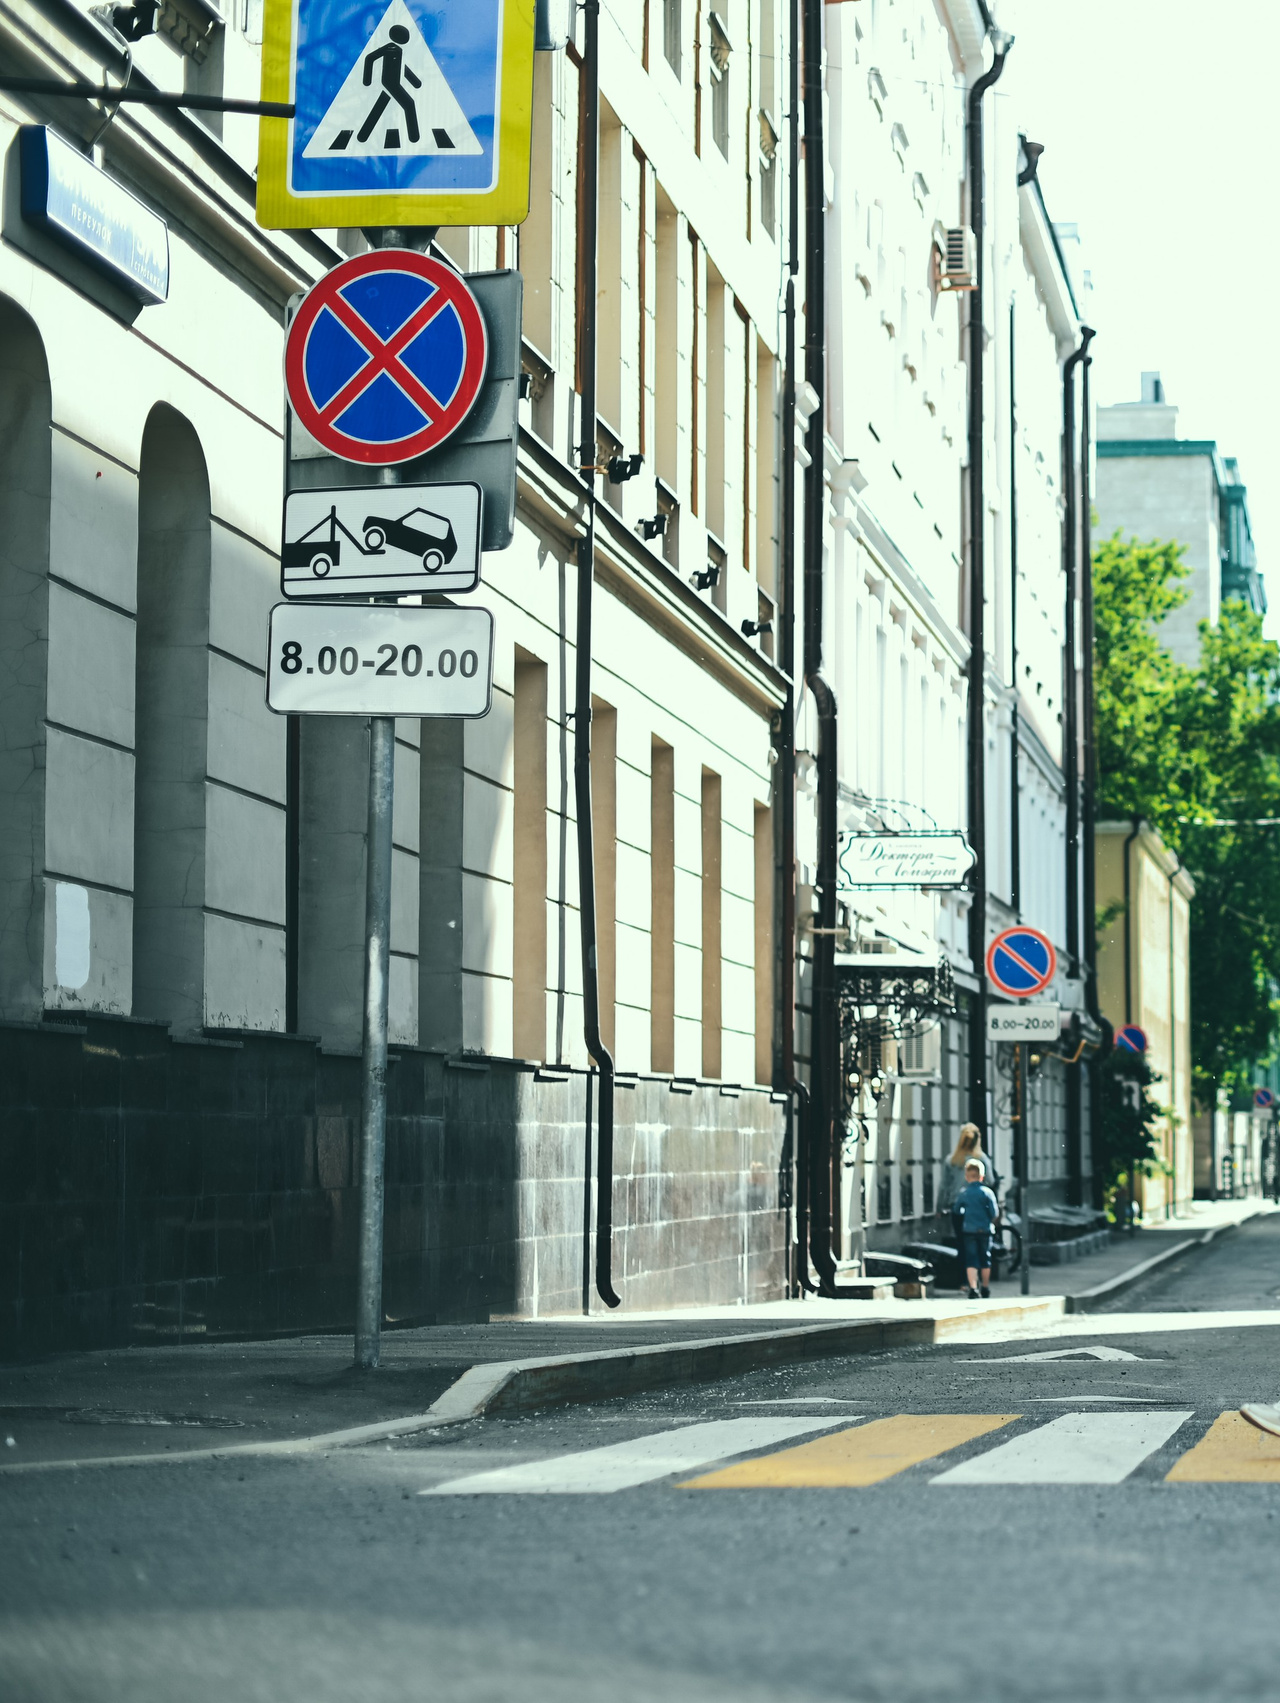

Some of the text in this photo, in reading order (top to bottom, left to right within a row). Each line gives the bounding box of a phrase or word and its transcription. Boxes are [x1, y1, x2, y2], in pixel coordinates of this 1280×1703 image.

[71, 203, 112, 245] ПЕРЕУЛОК
[280, 641, 479, 678] 8.00-20.00
[860, 842, 934, 867] Доктора
[991, 1018, 1055, 1029] 8.00-20.00
